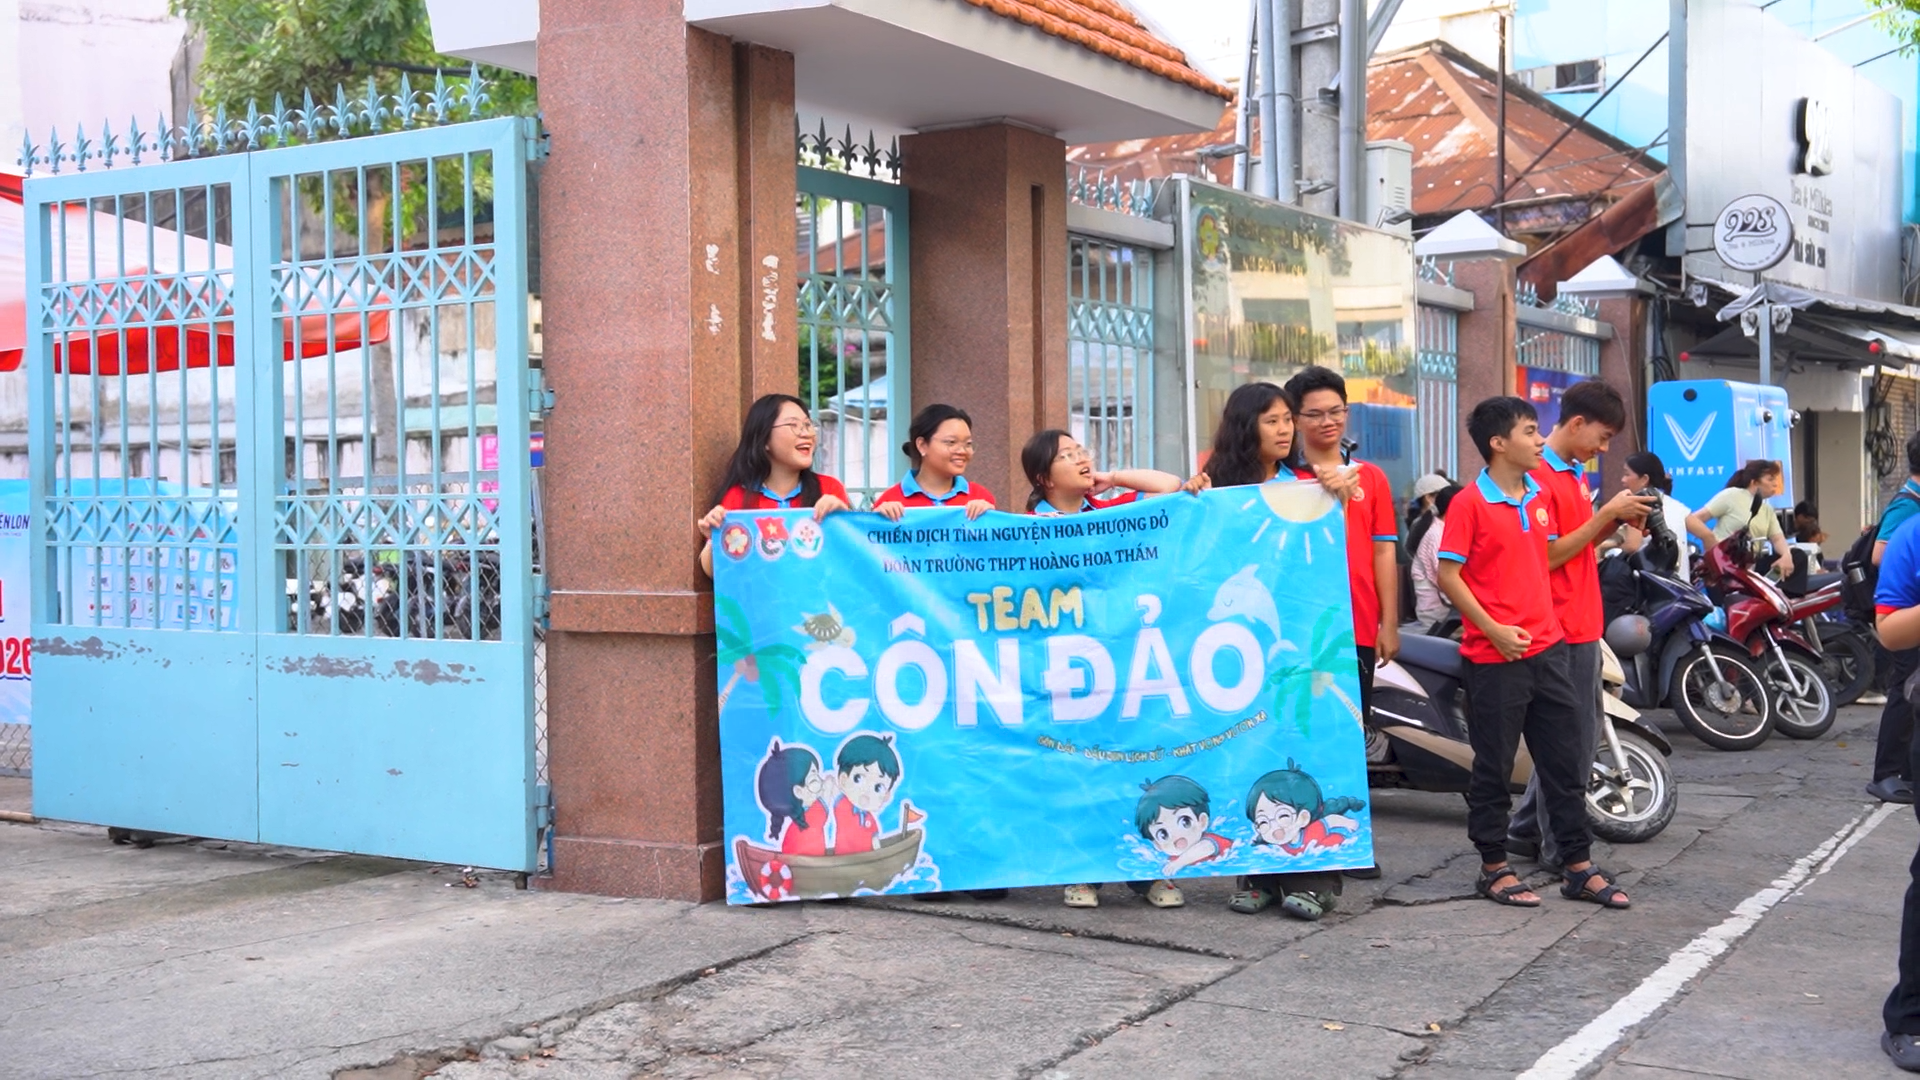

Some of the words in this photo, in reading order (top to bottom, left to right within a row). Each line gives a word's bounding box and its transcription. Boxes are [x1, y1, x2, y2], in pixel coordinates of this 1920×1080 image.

[1668, 464, 1725, 476] INFAST
[868, 525, 912, 544] CHIẾN
[916, 528, 950, 547] DỊCH
[953, 524, 988, 543] TÌNH
[991, 522, 1050, 545] NGUYỆN
[1054, 523, 1084, 538] HOA
[1087, 515, 1147, 538] PHƯỢNG
[1149, 509, 1169, 530] ĐỎ
[884, 555, 921, 573] ĐOÀN
[924, 553, 985, 573] TRƯỜNG
[988, 556, 1026, 572] THPT
[1029, 551, 1080, 571] HOÀNG
[1083, 551, 1113, 567] HOA
[1114, 542, 1159, 563] THÁM
[967, 586, 1085, 632] TEAM
[0, 637, 32, 677] 26
[799, 611, 1024, 735] CÔN
[1042, 593, 1265, 722] ĐẢO
